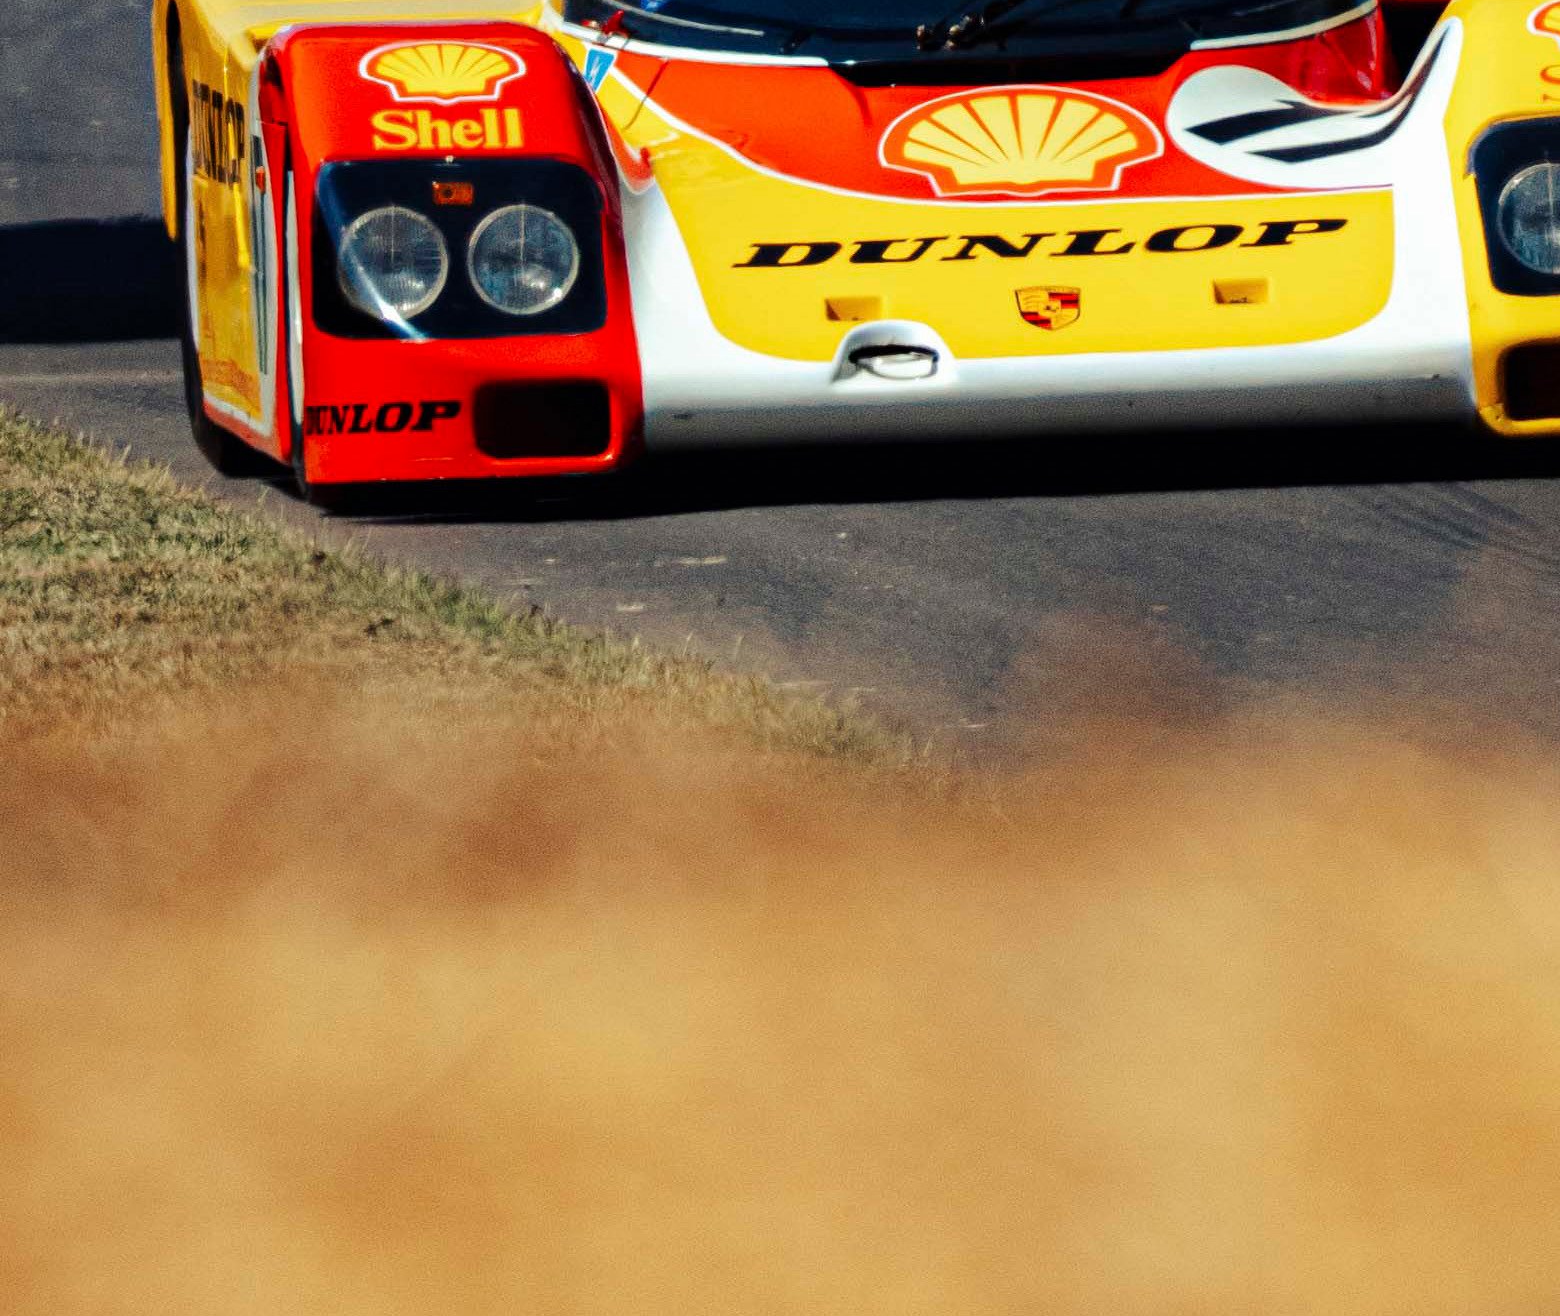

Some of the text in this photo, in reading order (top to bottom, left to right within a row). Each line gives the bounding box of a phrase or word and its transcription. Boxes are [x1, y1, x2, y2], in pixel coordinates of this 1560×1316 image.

[370, 108, 525, 151] Shell
[732, 218, 1349, 268] DUNLOP
[305, 400, 462, 436] DUNLOP
